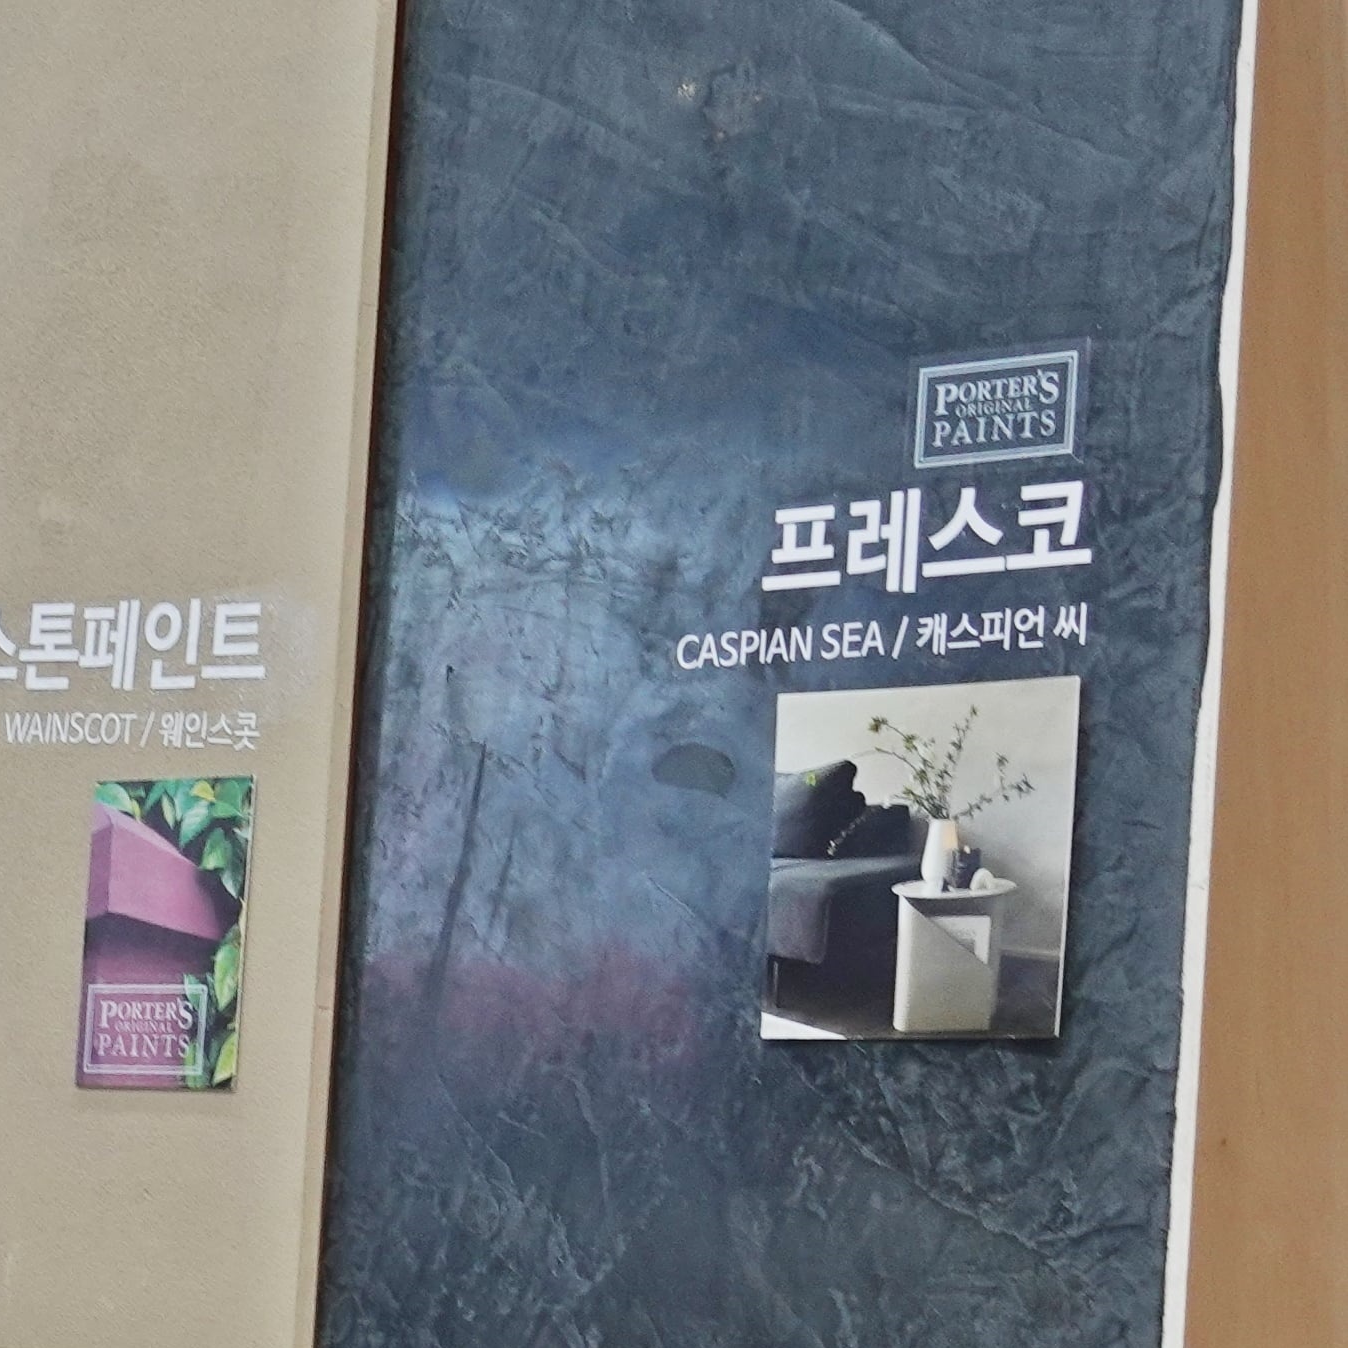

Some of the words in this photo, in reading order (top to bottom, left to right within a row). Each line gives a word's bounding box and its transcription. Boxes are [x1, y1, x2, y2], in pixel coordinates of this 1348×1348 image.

[933, 368, 1060, 417] PORTER'S
[955, 397, 1034, 418] ORIGINAL
[931, 409, 1056, 448] PAINTS
[761, 480, 1092, 594] 프레스코
[676, 625, 813, 670] CASPIAN
[820, 620, 885, 661] SEA
[891, 615, 910, 660] /
[916, 604, 1045, 657] 캐스피언
[1052, 601, 1089, 647] 씨
[4, 711, 137, 745] WAINSCOT
[139, 711, 156, 749] /
[158, 711, 261, 751] 웨인스콧
[98, 996, 194, 1030] PORTER'S
[97, 1033, 191, 1058] PAINTS
